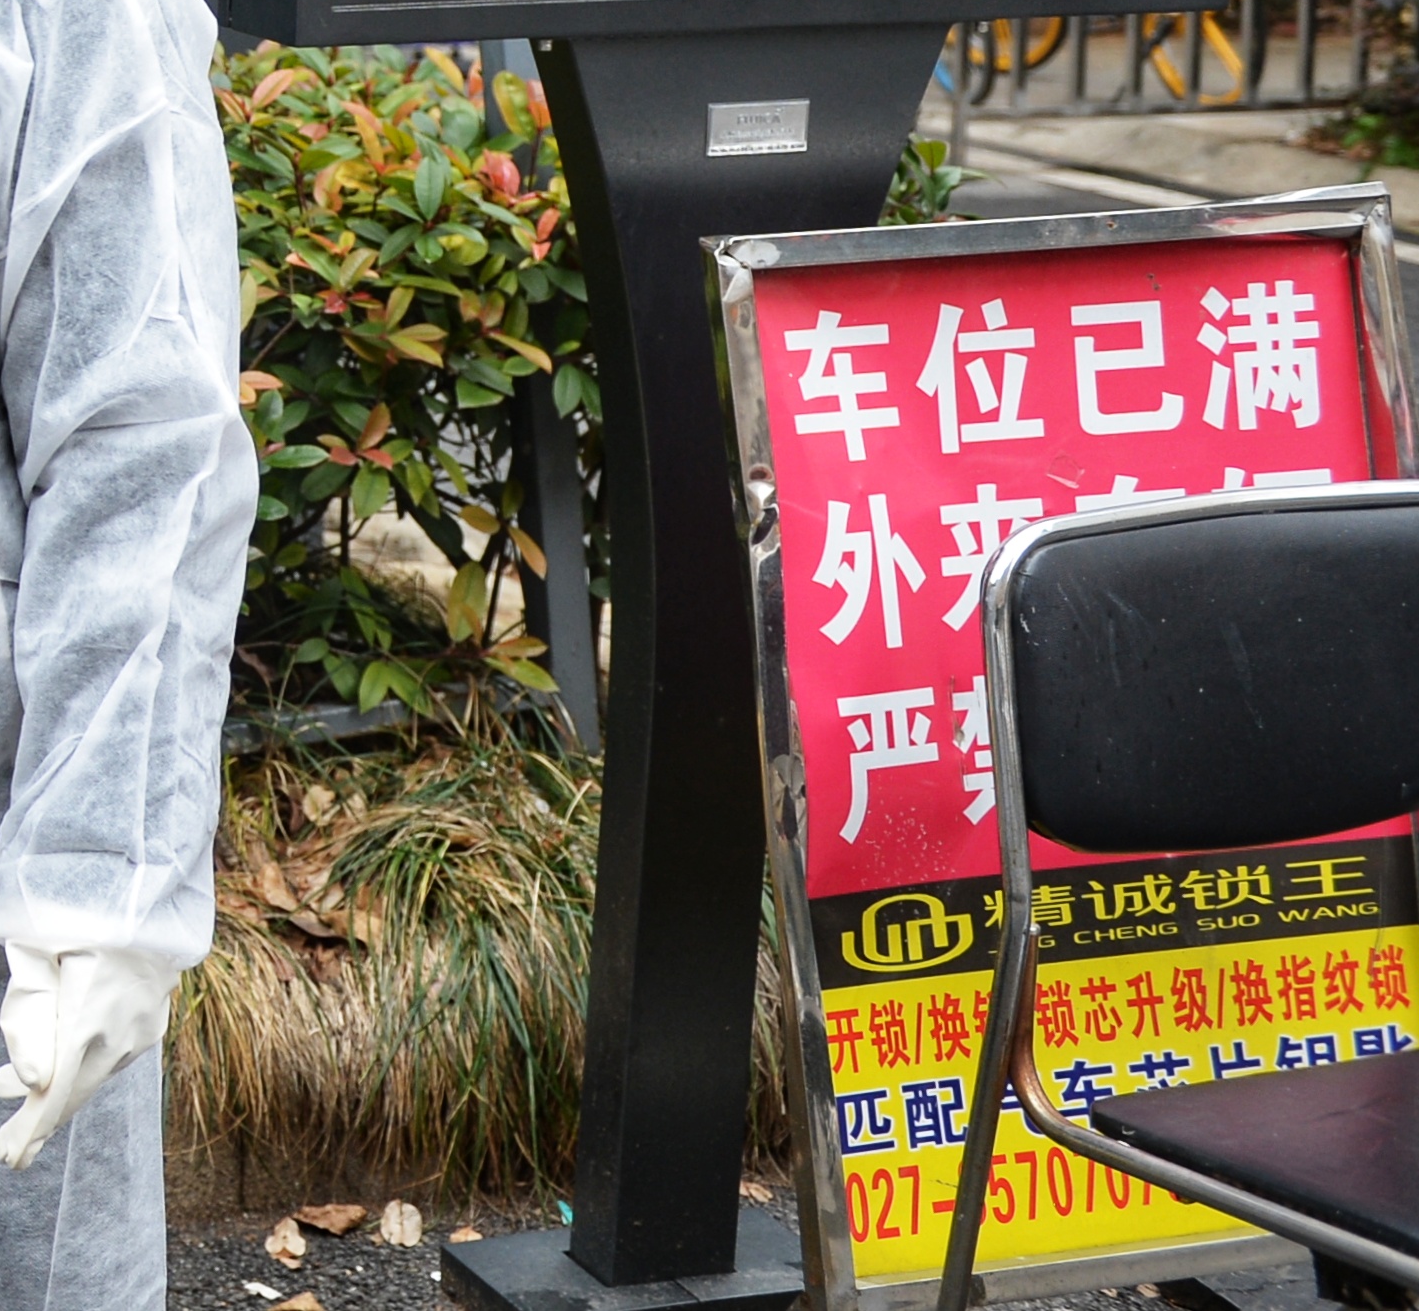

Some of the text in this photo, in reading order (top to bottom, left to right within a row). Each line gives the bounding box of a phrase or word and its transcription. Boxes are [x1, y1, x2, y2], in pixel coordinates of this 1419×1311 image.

[783, 279, 1322, 462] 车位已满
[812, 466, 1333, 650] 外来
[982, 856, 1375, 930] 精诚锁王
[1073, 901, 1380, 944] CHENG SUO WANG
[825, 944, 1411, 1074] 开锁/换锁芯升级/换指纹锁
